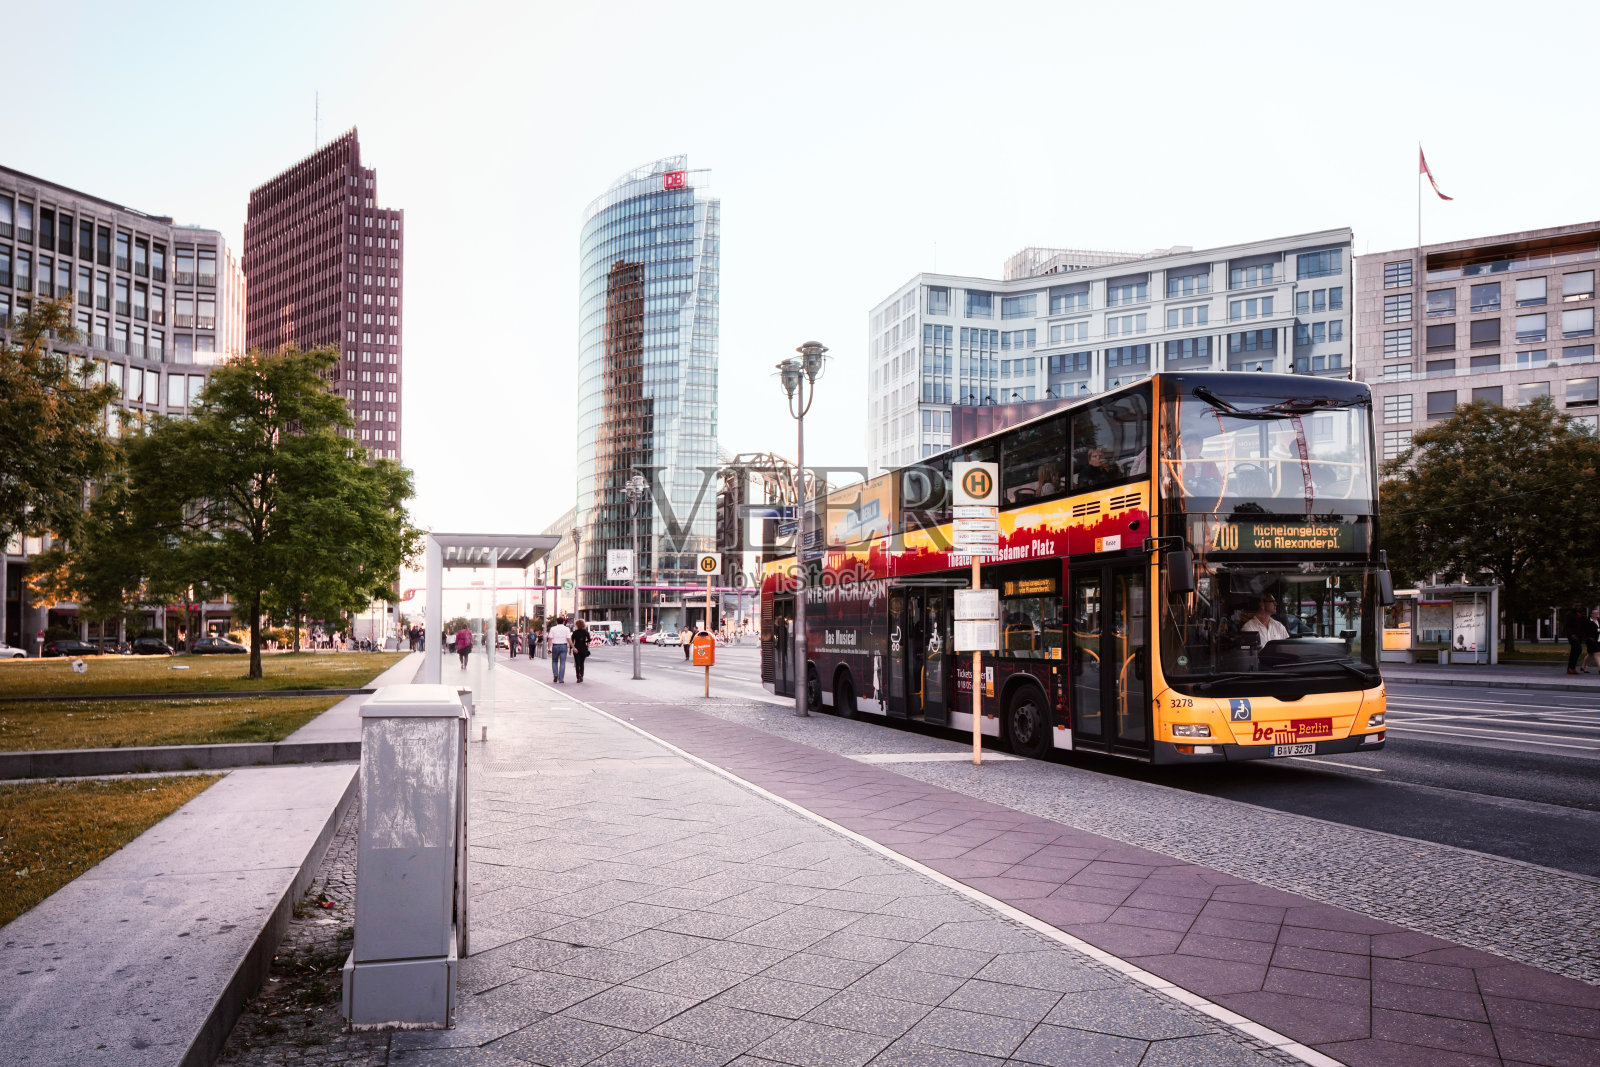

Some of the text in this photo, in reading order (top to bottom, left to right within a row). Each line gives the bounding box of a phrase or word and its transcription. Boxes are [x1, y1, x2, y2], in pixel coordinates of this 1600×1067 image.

[666, 174, 682, 186] DB
[971, 475, 985, 492] H
[1212, 524, 1239, 551] 200
[1254, 524, 1342, 538] Michelangelostr.
[1032, 538, 1055, 557] Platz
[1254, 537, 1340, 550] via Alexanderpl.
[825, 629, 857, 646] Das Musical
[956, 668, 973, 679] Tickets
[1170, 698, 1194, 708] 3278
[1252, 721, 1329, 742] be Berlin
[1294, 744, 1313, 755] 3278
